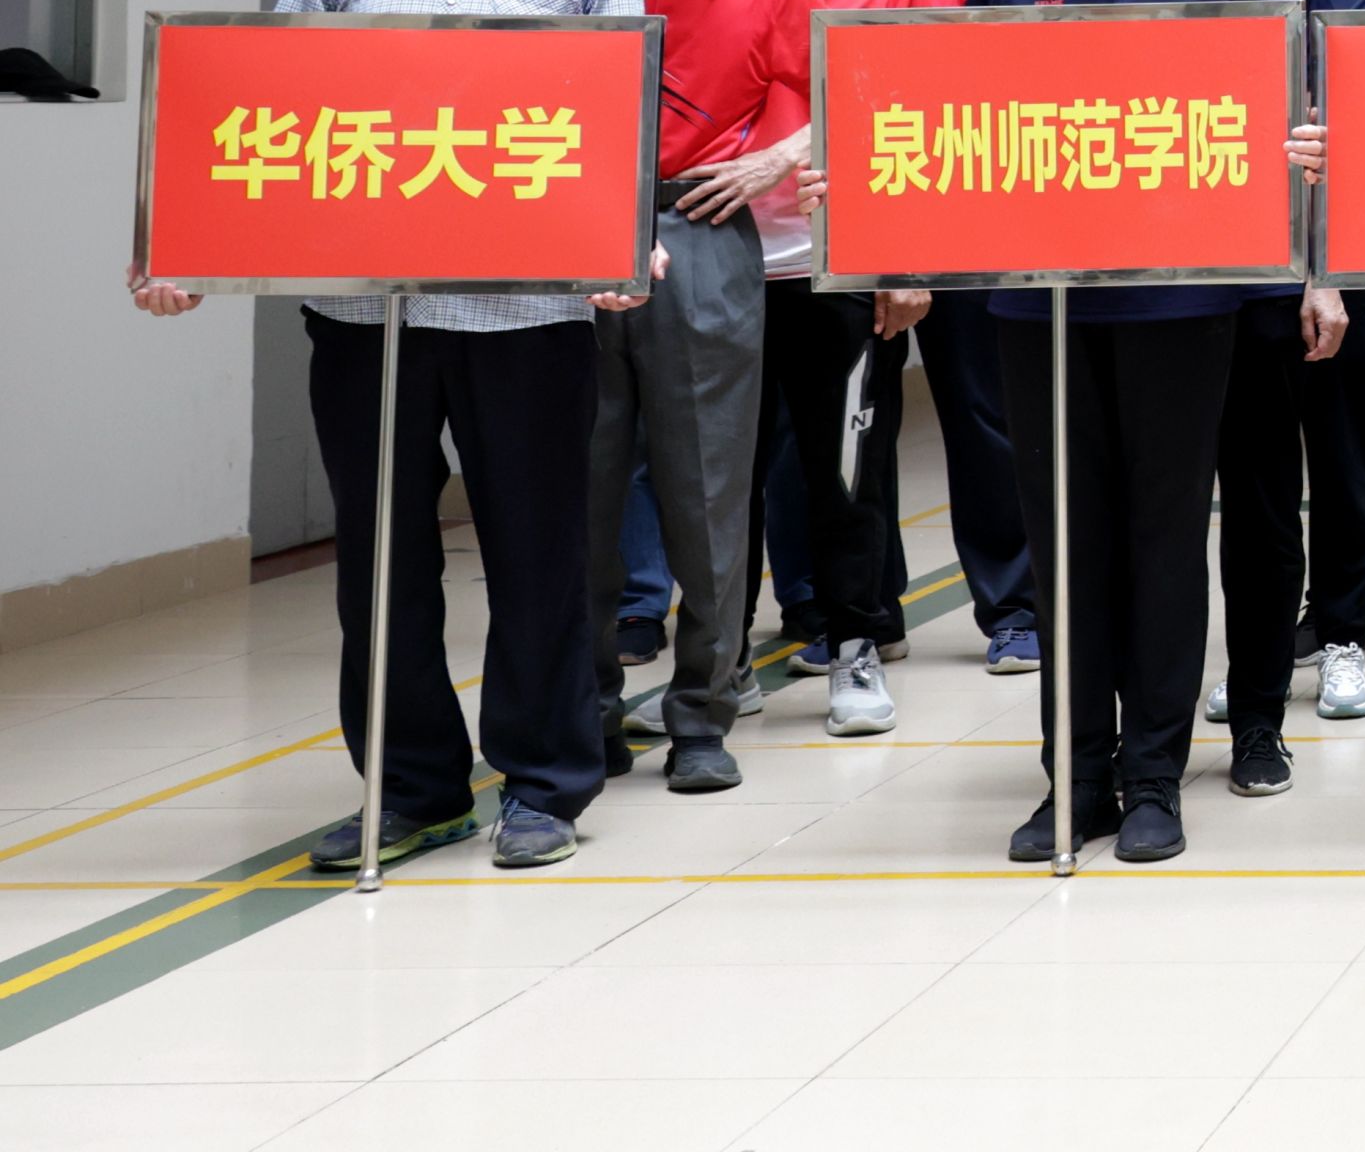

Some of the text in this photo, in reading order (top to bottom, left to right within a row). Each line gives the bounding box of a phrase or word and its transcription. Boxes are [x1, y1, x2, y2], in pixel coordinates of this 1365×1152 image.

[212, 107, 581, 199] 华侨大学
[869, 95, 1249, 195] 泉州师范学院
